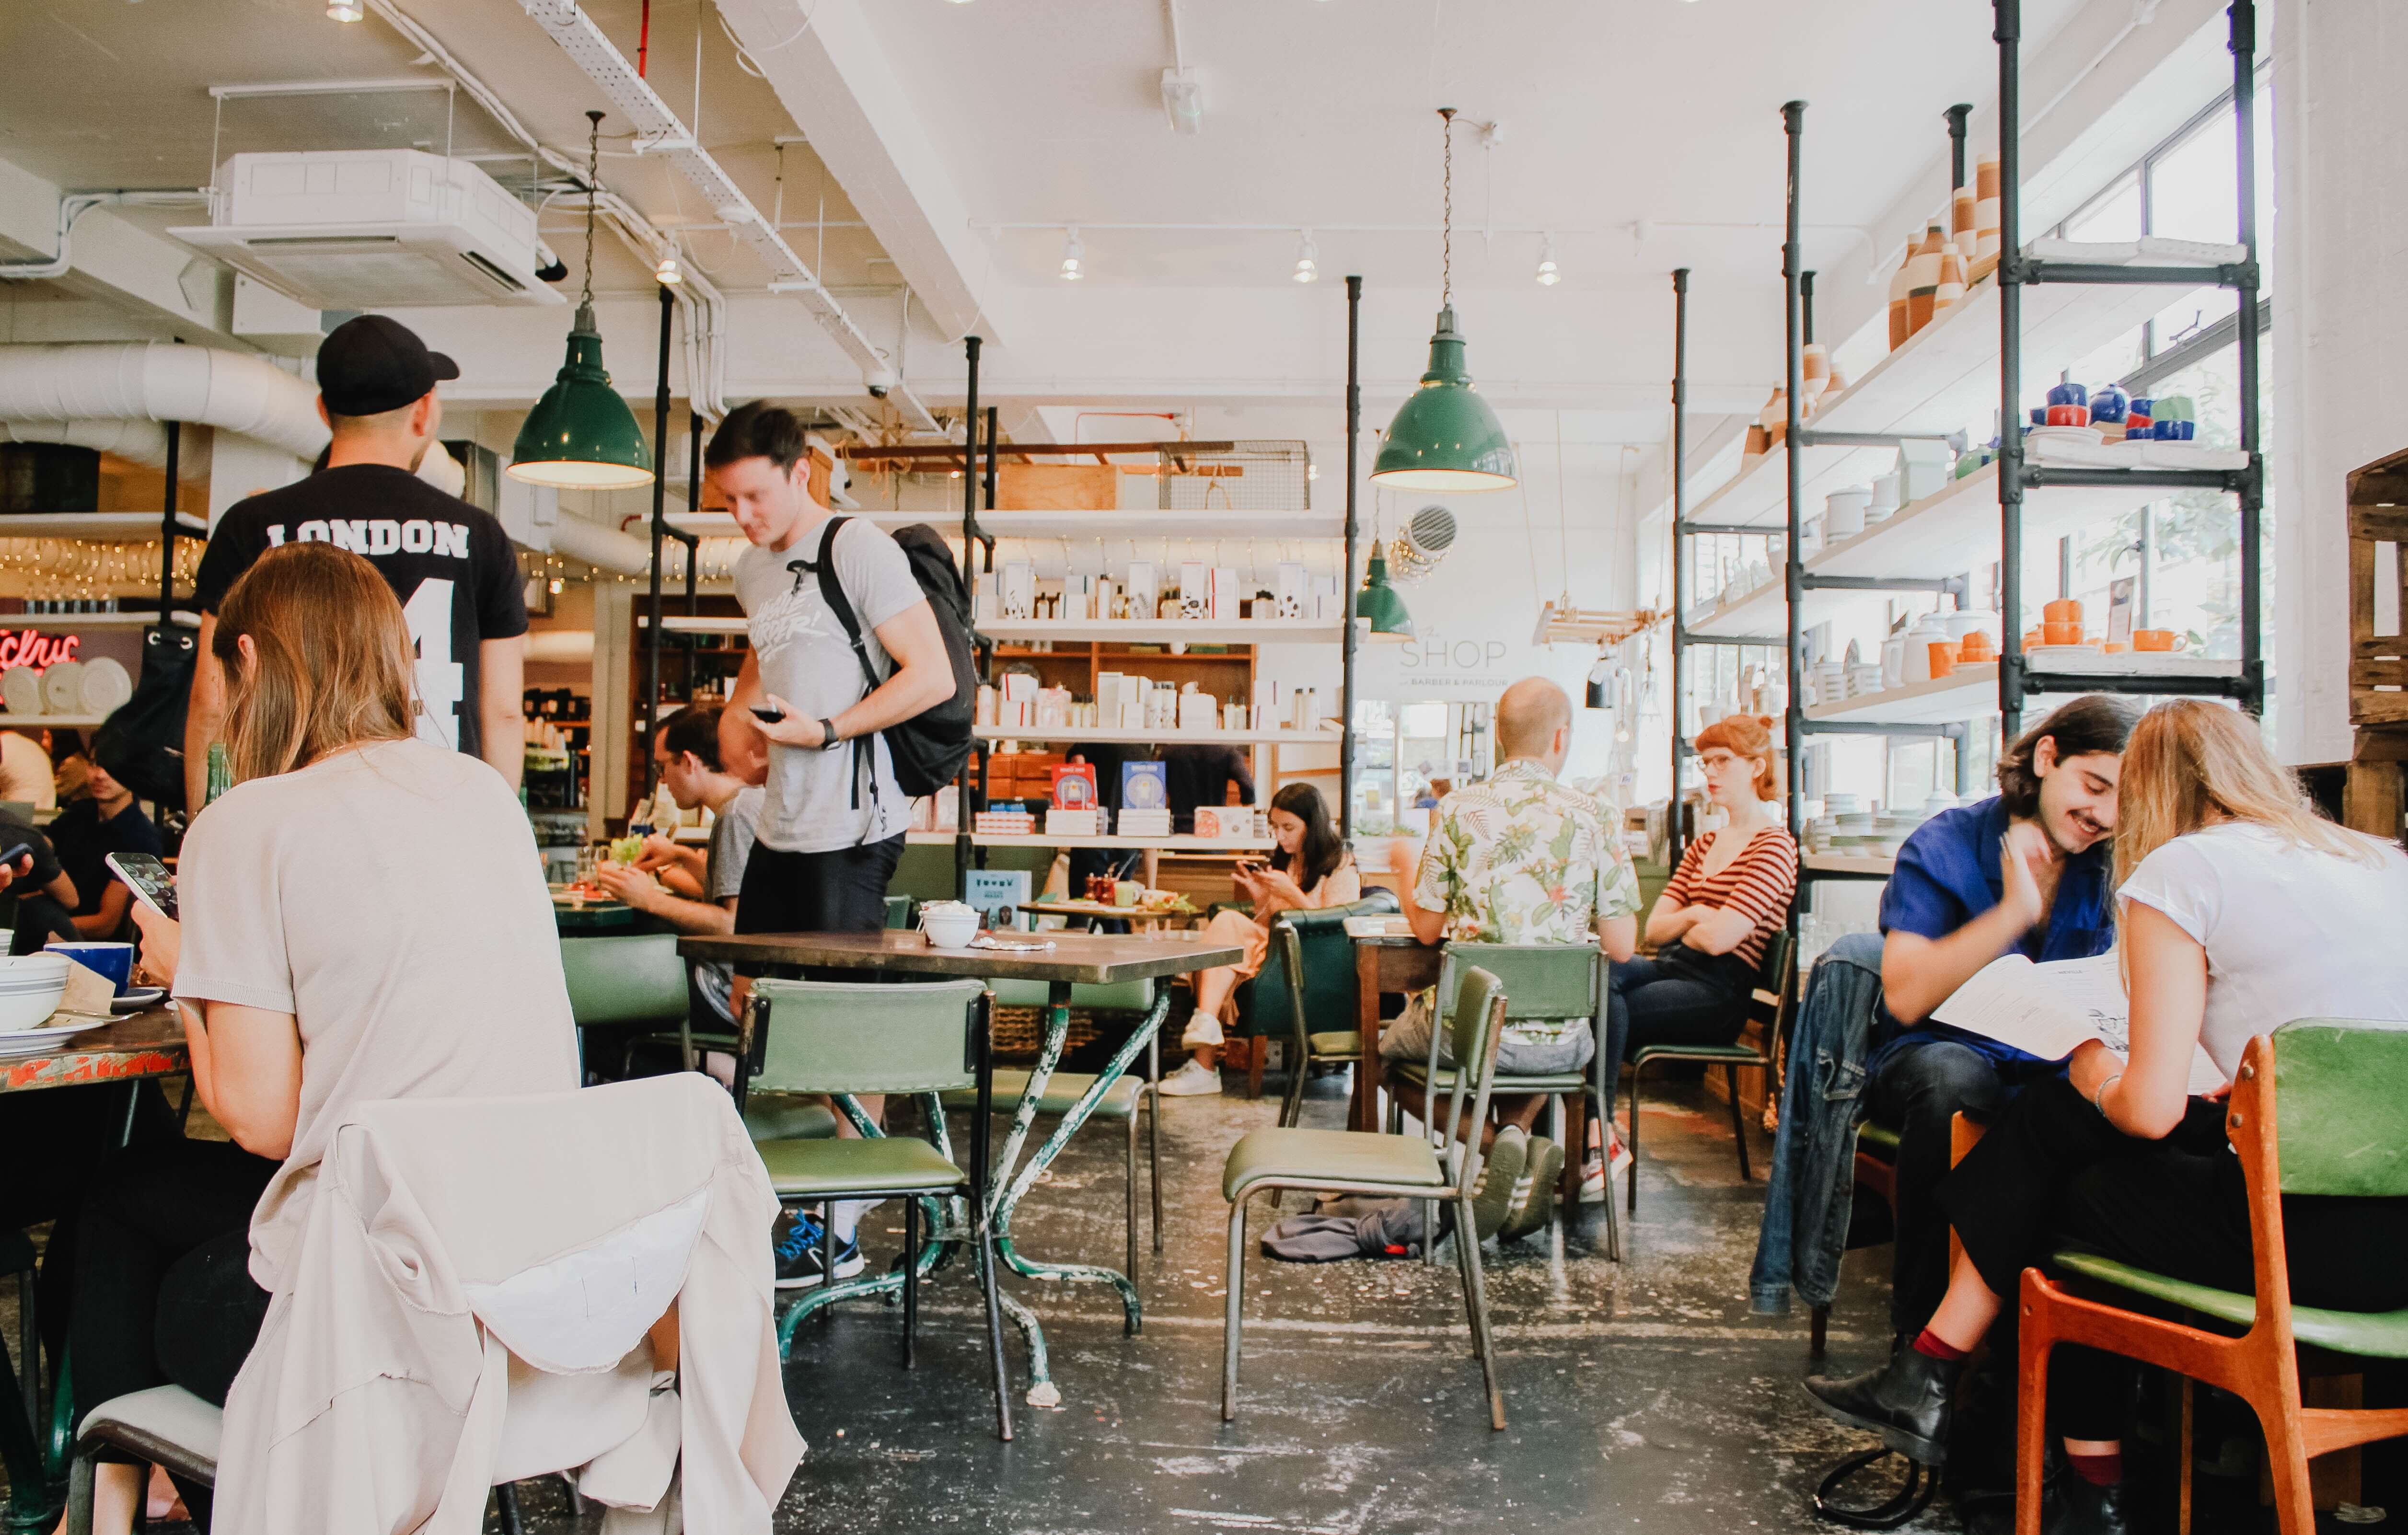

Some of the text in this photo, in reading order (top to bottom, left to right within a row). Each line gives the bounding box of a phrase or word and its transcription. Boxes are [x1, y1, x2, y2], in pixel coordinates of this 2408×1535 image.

[0, 628, 80, 670] ctric
[1400, 640, 1506, 668] SHOP
[1462, 678, 1508, 687] PARLOUR
